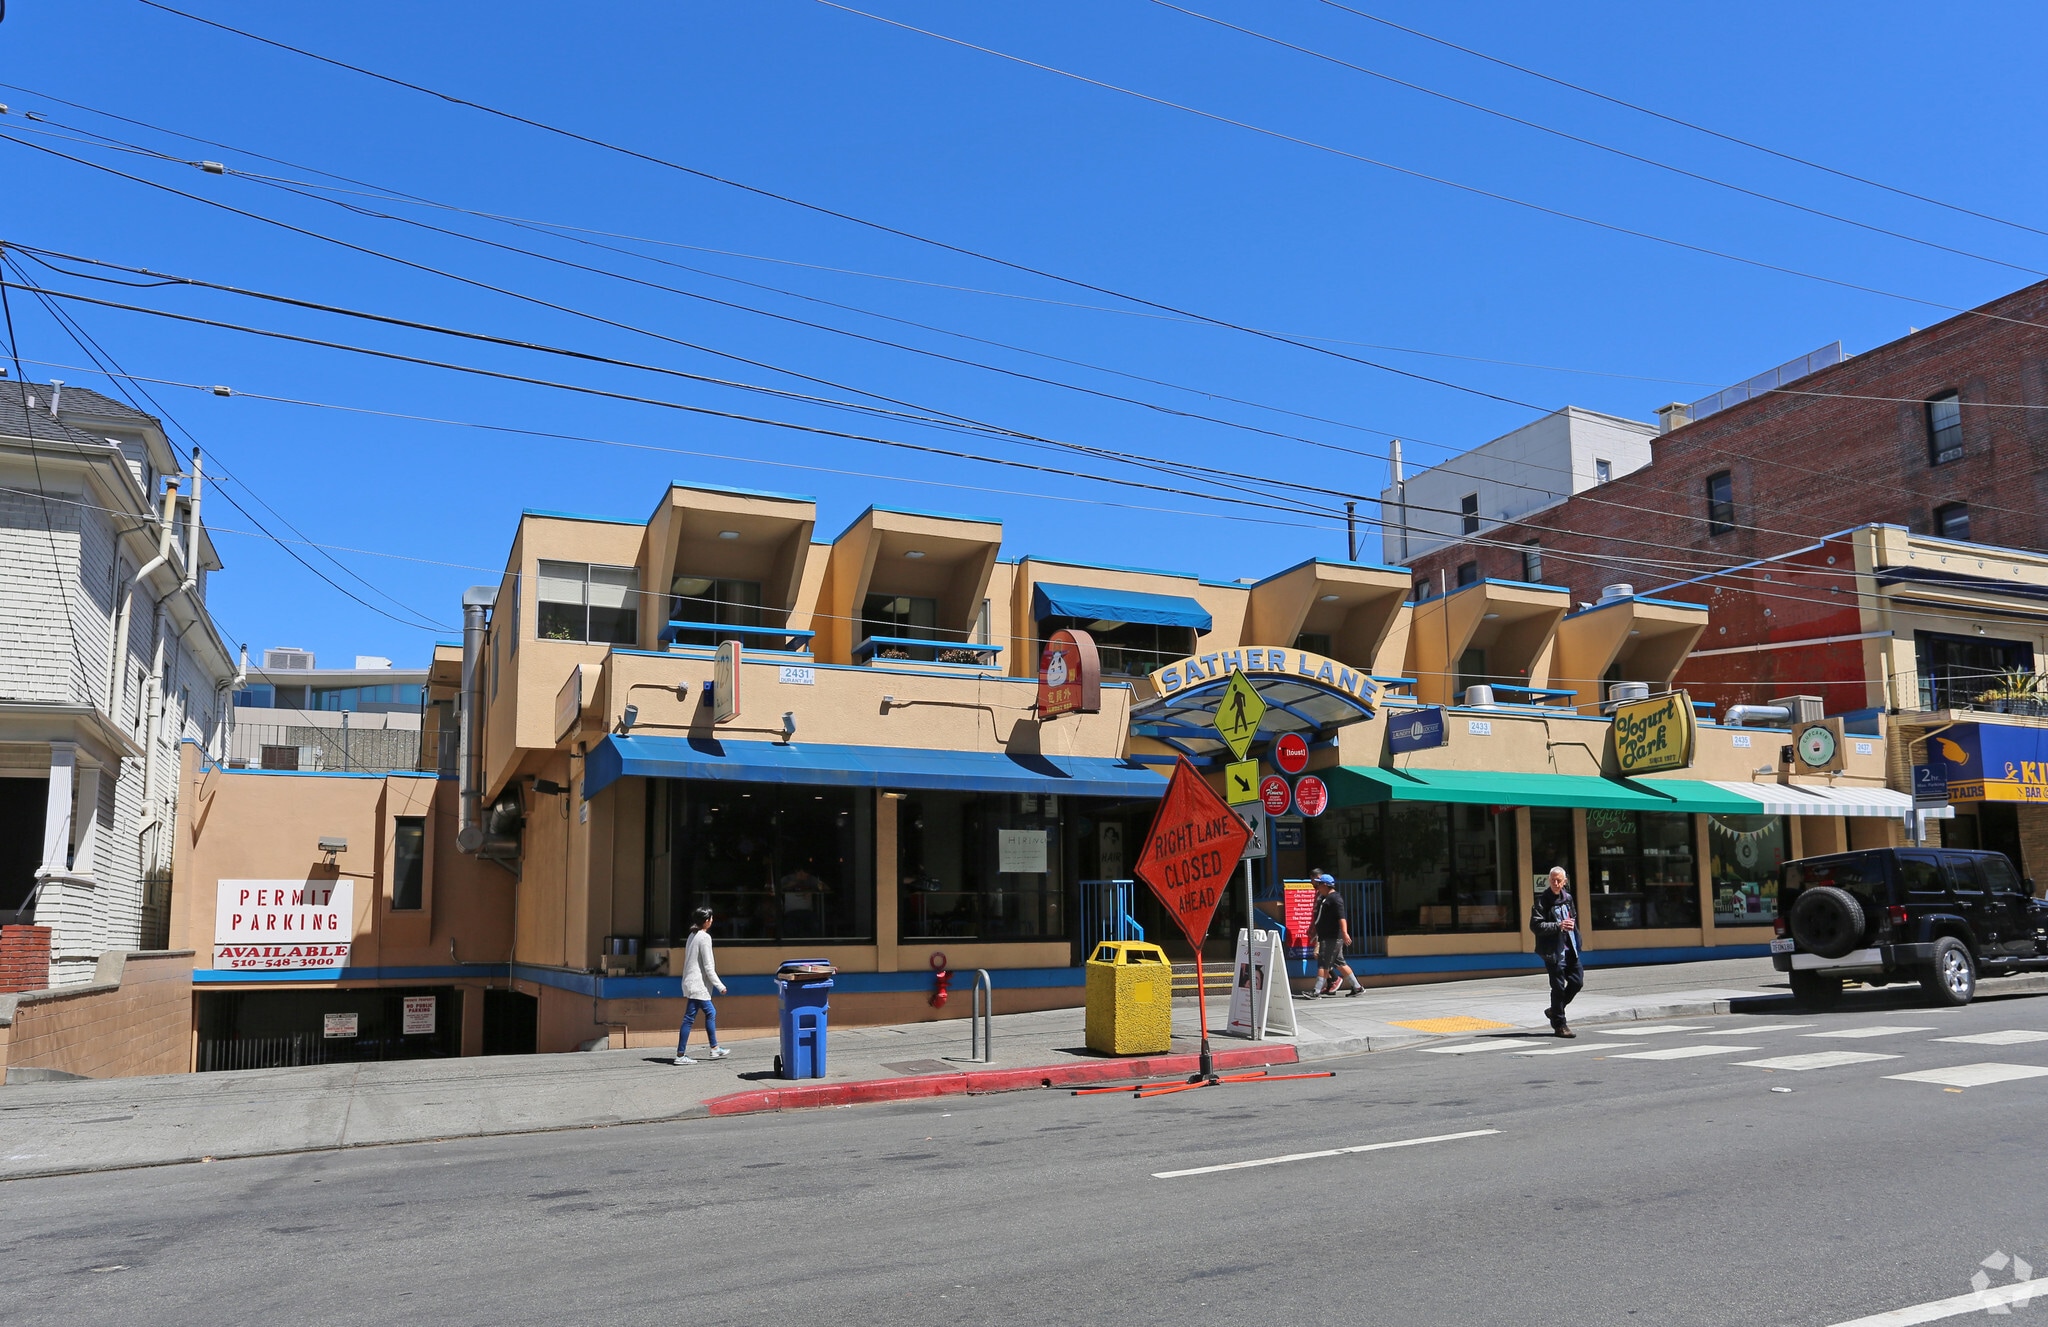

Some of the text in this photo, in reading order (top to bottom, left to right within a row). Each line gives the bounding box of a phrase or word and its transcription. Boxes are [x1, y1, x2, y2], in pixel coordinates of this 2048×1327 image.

[785, 668, 810, 679] 2431
[1161, 648, 1378, 704] SATHER LANE
[1471, 722, 1488, 731] 2433
[1616, 699, 1675, 749] Yogurt
[1622, 725, 1668, 769] Park
[1265, 788, 1284, 796] Flowers
[1269, 782, 1279, 790] Cal
[2025, 786, 2041, 798] BAR
[1155, 815, 1230, 860] RIGHT LANE
[1164, 850, 1222, 889] CLOSED
[1536, 876, 1546, 887] Cal
[239, 889, 331, 906] PERMIT
[1180, 887, 1215, 915] AHEAD
[232, 913, 338, 931] PARKING
[217, 945, 349, 958] AVAILABLE
[231, 958, 334, 968] 510-548-3900
